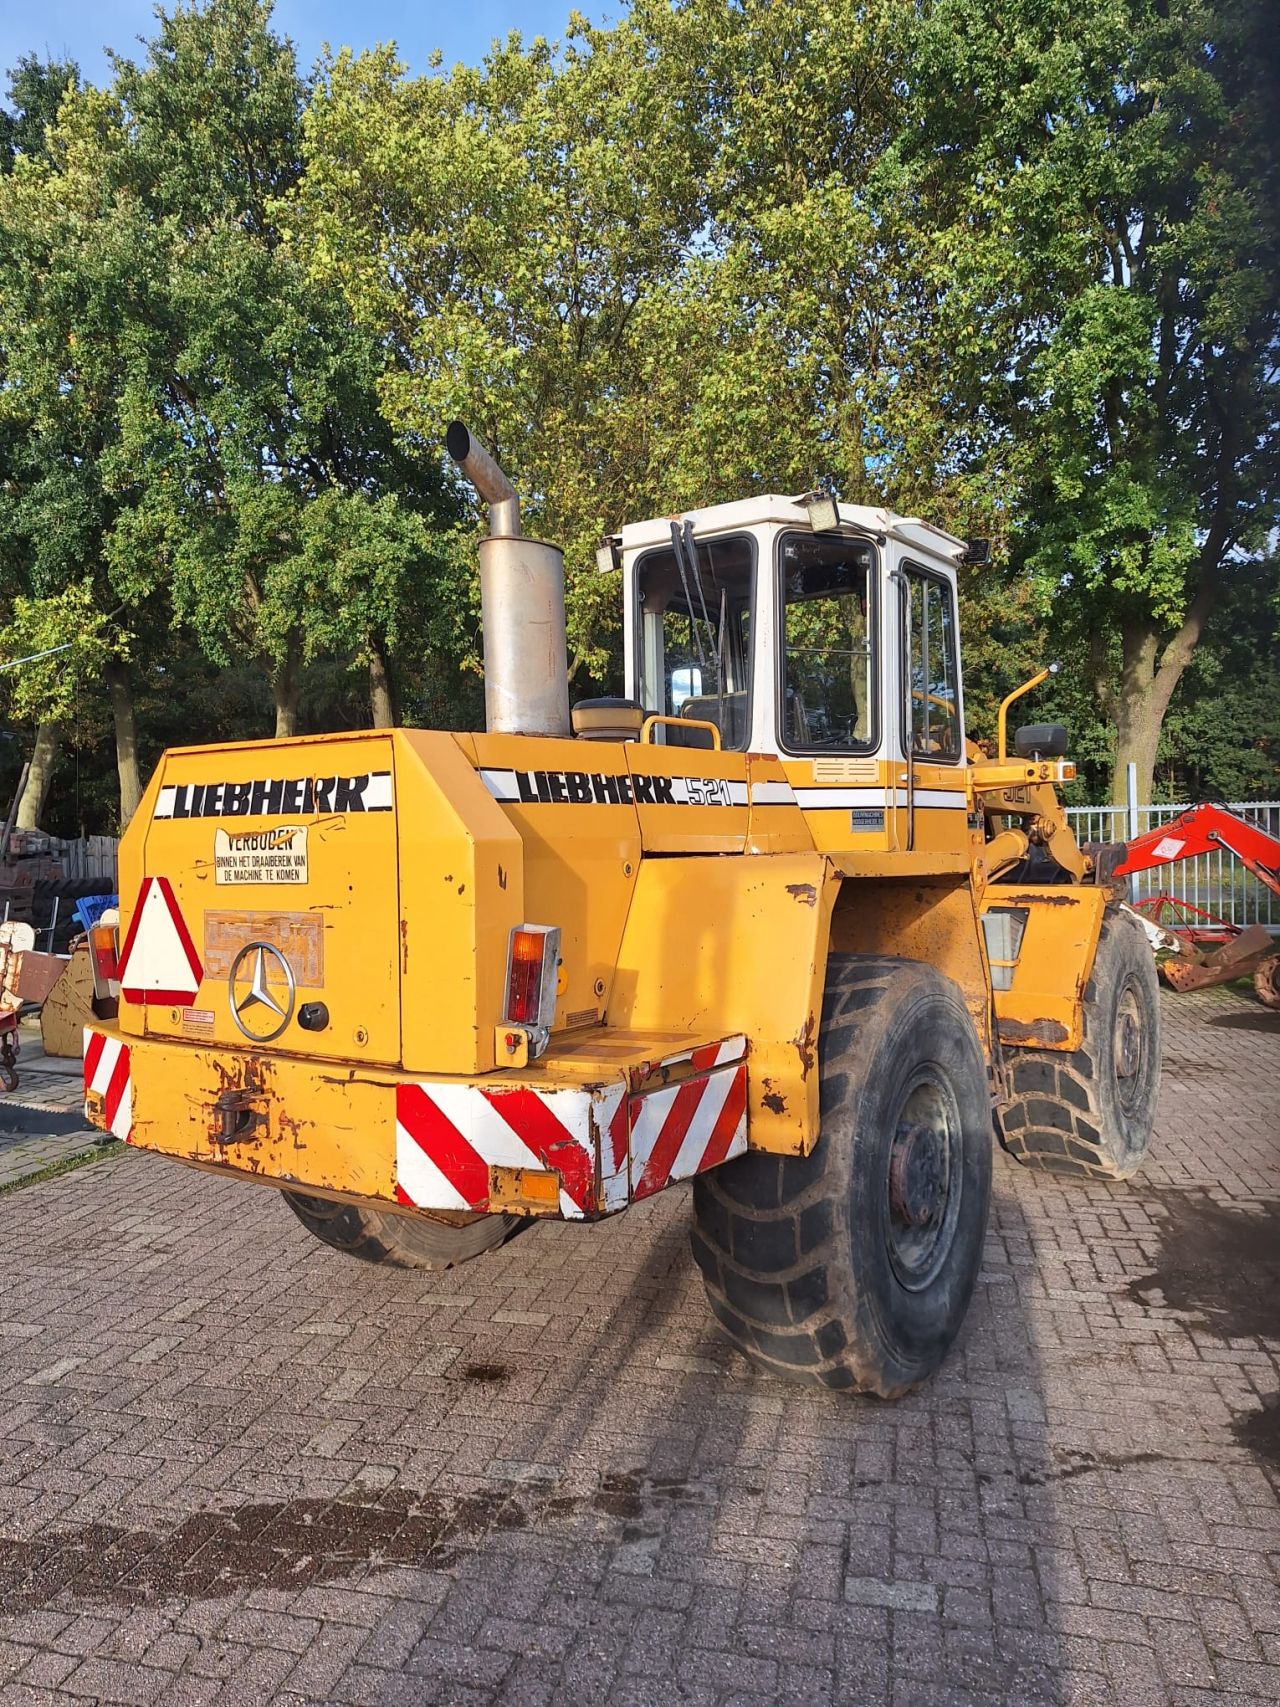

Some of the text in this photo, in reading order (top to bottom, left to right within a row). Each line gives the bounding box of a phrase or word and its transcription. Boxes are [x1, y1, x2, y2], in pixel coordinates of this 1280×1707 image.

[173, 773, 369, 818] LIEBHERR
[515, 769, 731, 806] LIEBHERR 521
[216, 855, 305, 868] BINNEN HET DRAAIBEREIK VAN
[224, 869, 300, 881] DE MACHINE TE KOMEN
